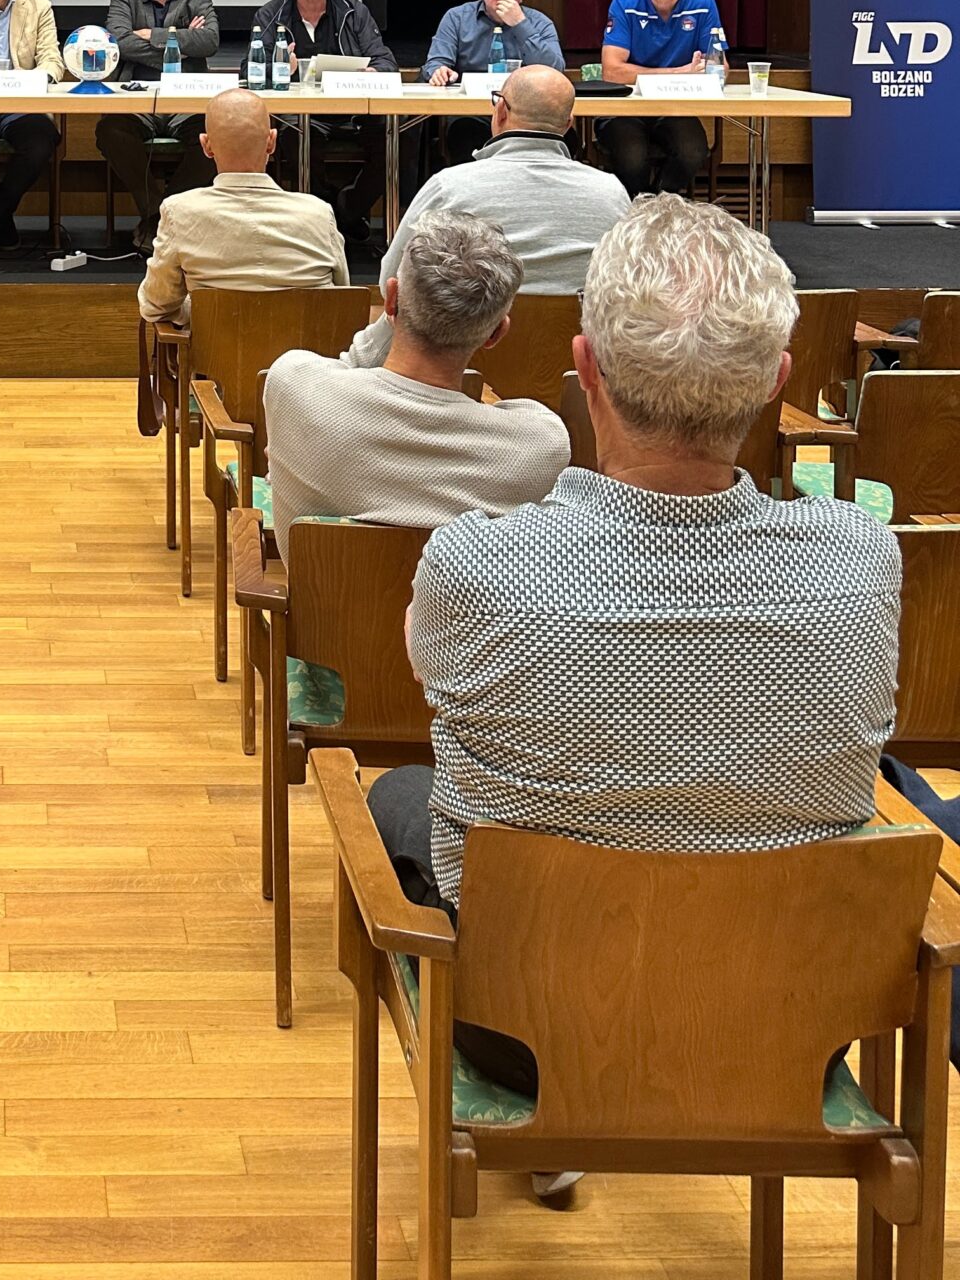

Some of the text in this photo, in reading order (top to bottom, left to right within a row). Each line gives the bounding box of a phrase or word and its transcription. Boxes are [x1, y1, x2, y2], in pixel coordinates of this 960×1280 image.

[851, 11, 875, 22] FIGC
[851, 22, 953, 65] LND
[871, 70, 933, 84] BOLZANO
[173, 83, 223, 91] SCHUSTER
[656, 85, 703, 93] STOCKER
[880, 83, 924, 98] BOZEN
